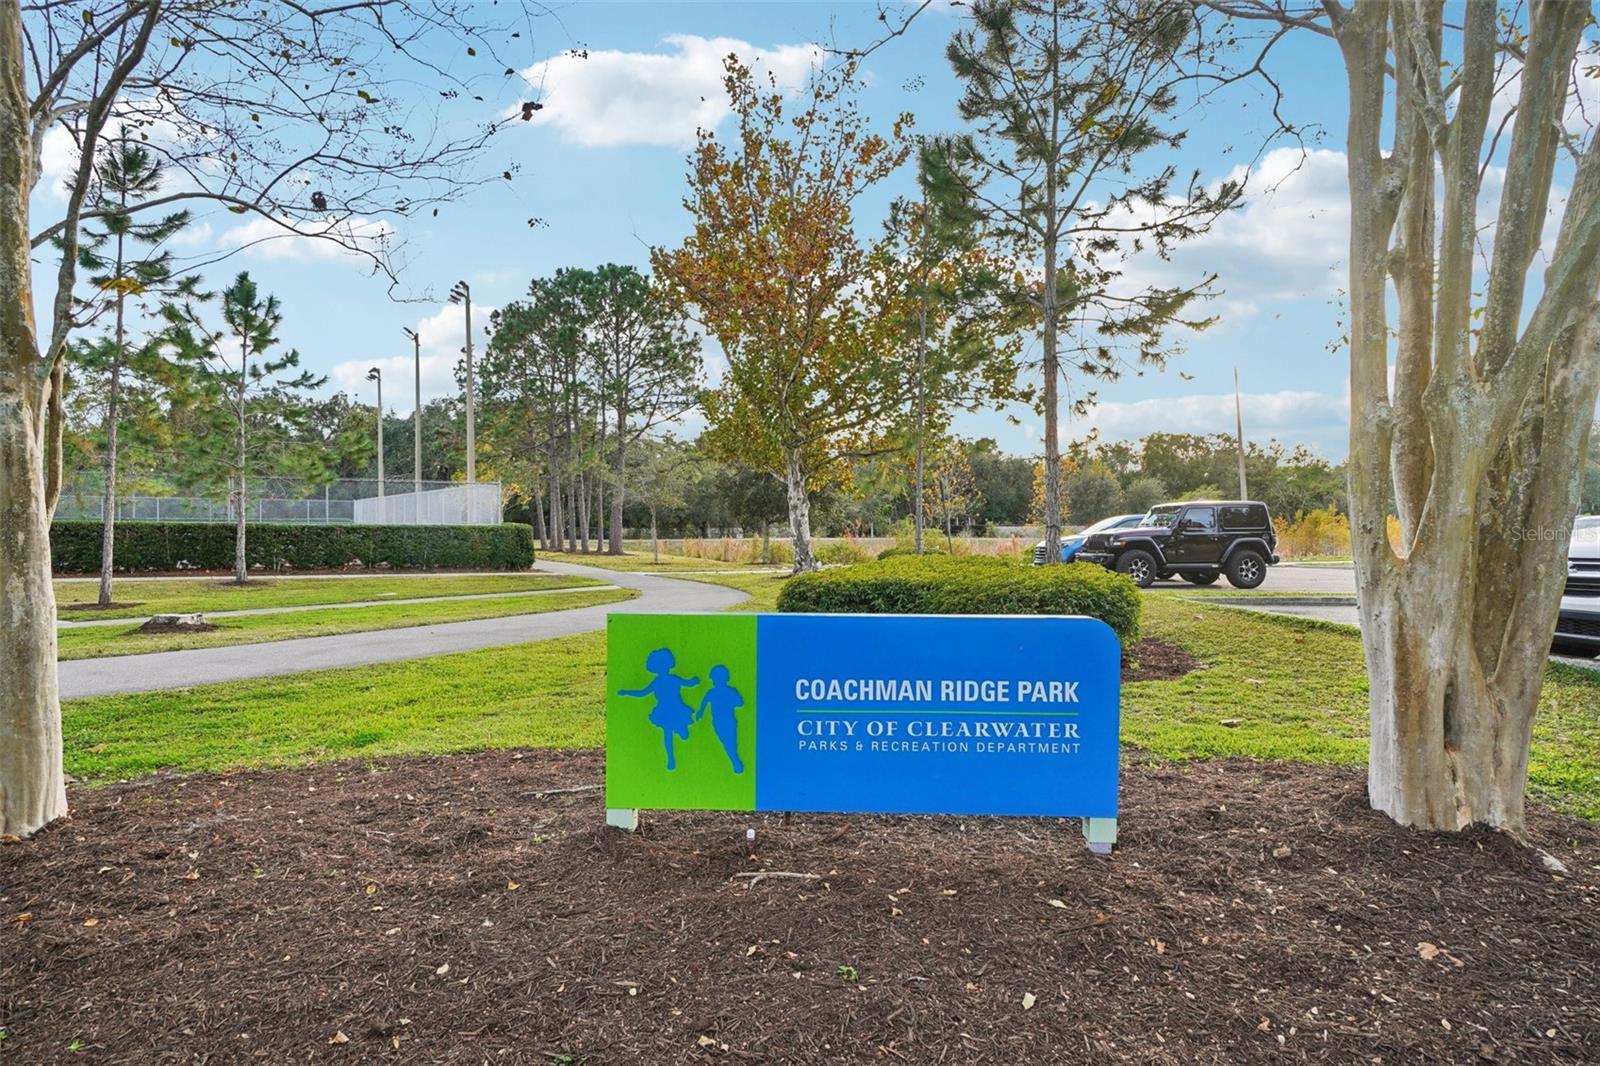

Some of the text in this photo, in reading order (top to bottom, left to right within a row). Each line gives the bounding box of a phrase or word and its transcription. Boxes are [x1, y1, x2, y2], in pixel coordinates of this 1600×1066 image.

[795, 678, 1080, 703] COACHMAN RIDGE PARK
[797, 719, 1081, 739] CITY OF CLEARWATER
[799, 740, 1081, 755] PARKS & RECREATION DEPARTMENT
